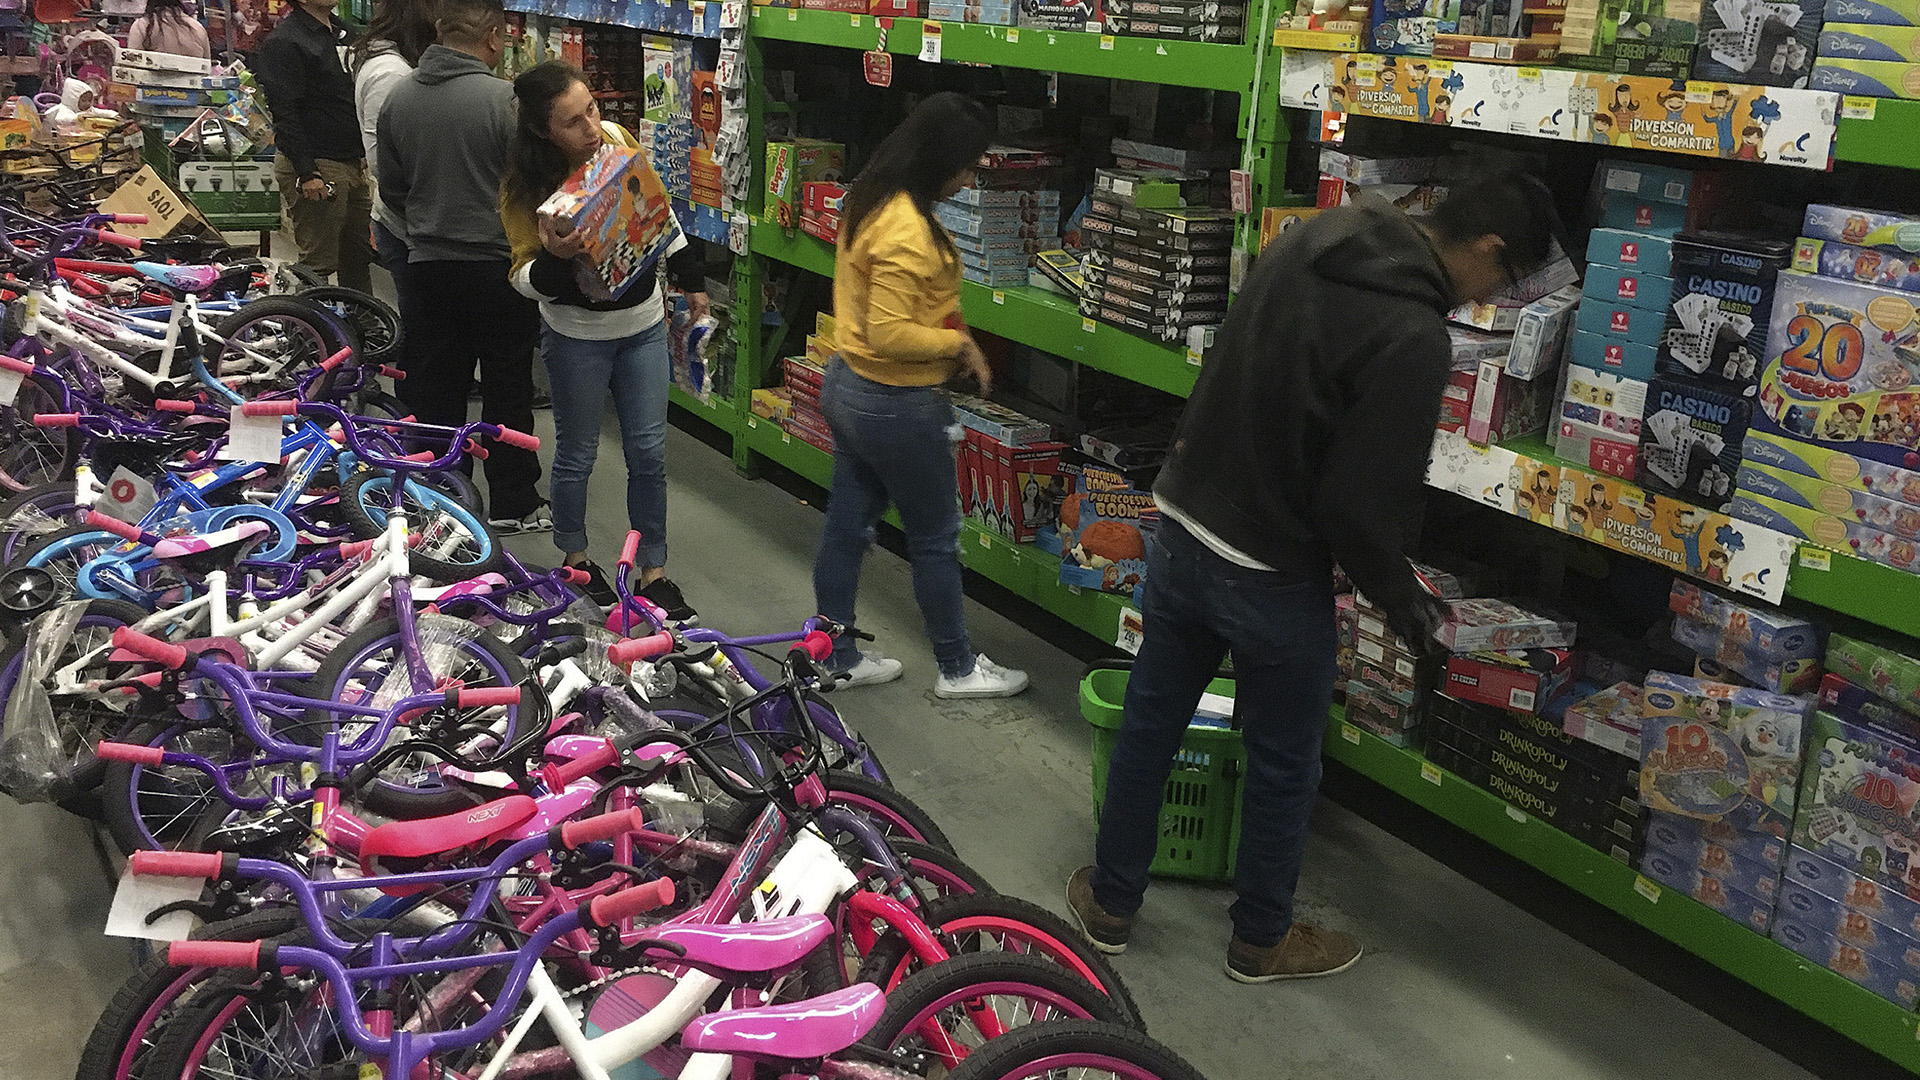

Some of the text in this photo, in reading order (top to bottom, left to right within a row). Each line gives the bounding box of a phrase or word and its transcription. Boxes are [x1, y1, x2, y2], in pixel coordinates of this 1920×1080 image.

[1836, 2, 1873, 19] Disney
[1830, 35, 1866, 54] Disney
[1821, 69, 1858, 88] Disney
[1372, 105, 1417, 117] COMPARTIR!
[1461, 119, 1481, 127] Novelty
[1650, 133, 1717, 151] COMPARTIR!
[147, 189, 175, 221] TOYS
[1721, 253, 1763, 270] CASINO
[1688, 275, 1763, 304] CASINO
[1781, 315, 1865, 382] 20
[1780, 371, 1850, 398] JUEGOS
[1660, 391, 1730, 424] CASINO
[1753, 442, 1785, 464] Disney
[1746, 472, 1779, 494] Disney
[1096, 502, 1140, 519] BOOM
[1740, 503, 1773, 524] Disney
[1621, 536, 1684, 565] COMPARTIR!
[1741, 582, 1767, 597] Novelty
[1665, 724, 1710, 753] 10
[1500, 729, 1568, 771] DRINKOPOLY
[1491, 750, 1559, 792] DRINKOPOLY
[1490, 774, 1557, 817] DRINKOPOLY
[1864, 771, 1896, 809] 10
[468, 802, 506, 823] NEXT
[1834, 792, 1913, 838] JUEGOS
